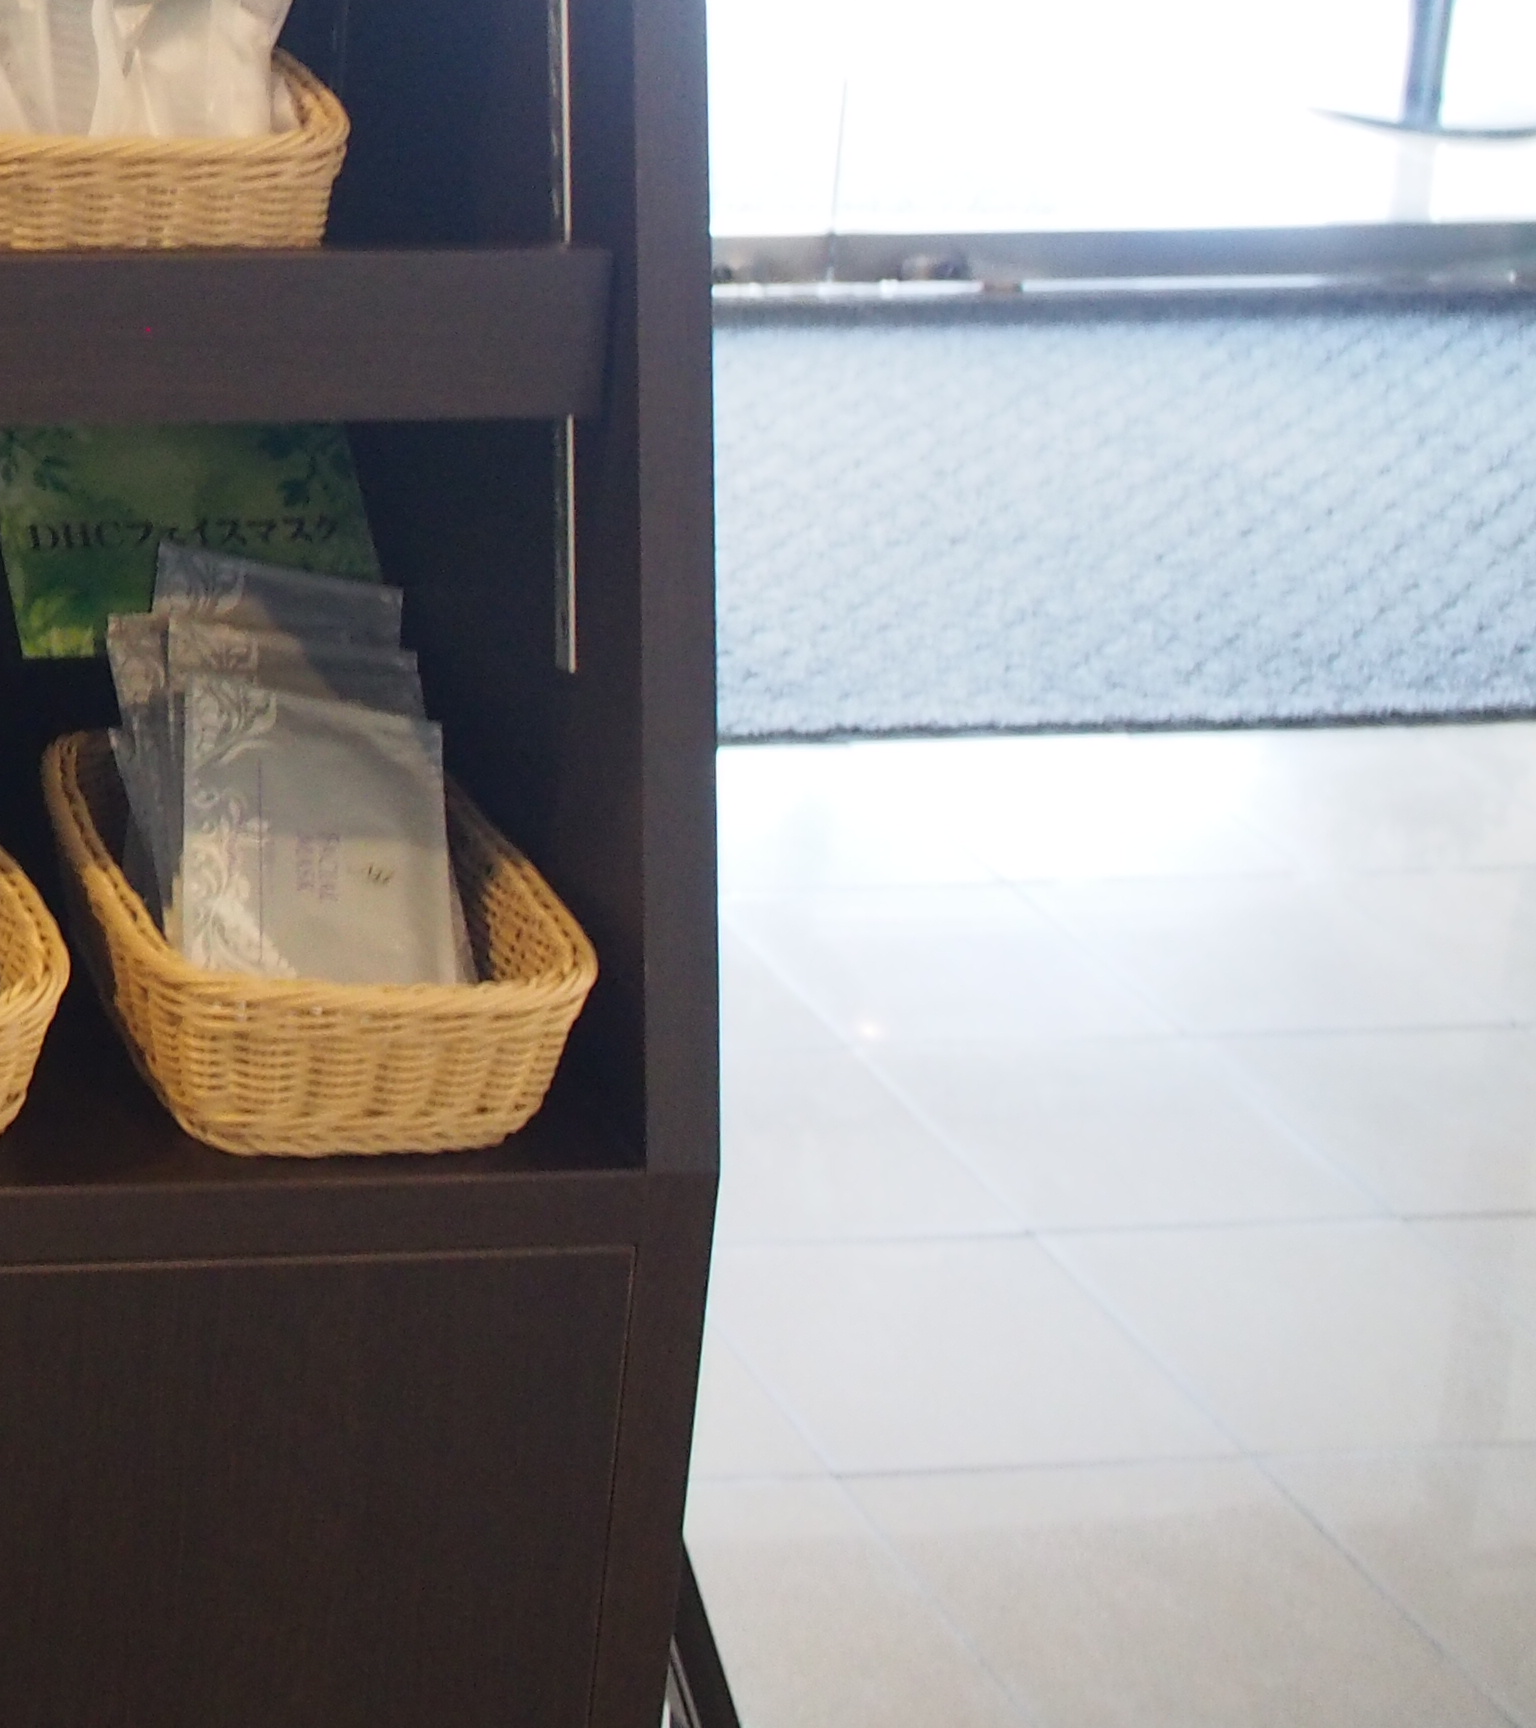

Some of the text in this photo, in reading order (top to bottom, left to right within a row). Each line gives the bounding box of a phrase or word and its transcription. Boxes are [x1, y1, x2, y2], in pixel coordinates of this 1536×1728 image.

[28, 514, 340, 552] DHCフェイスマスク
